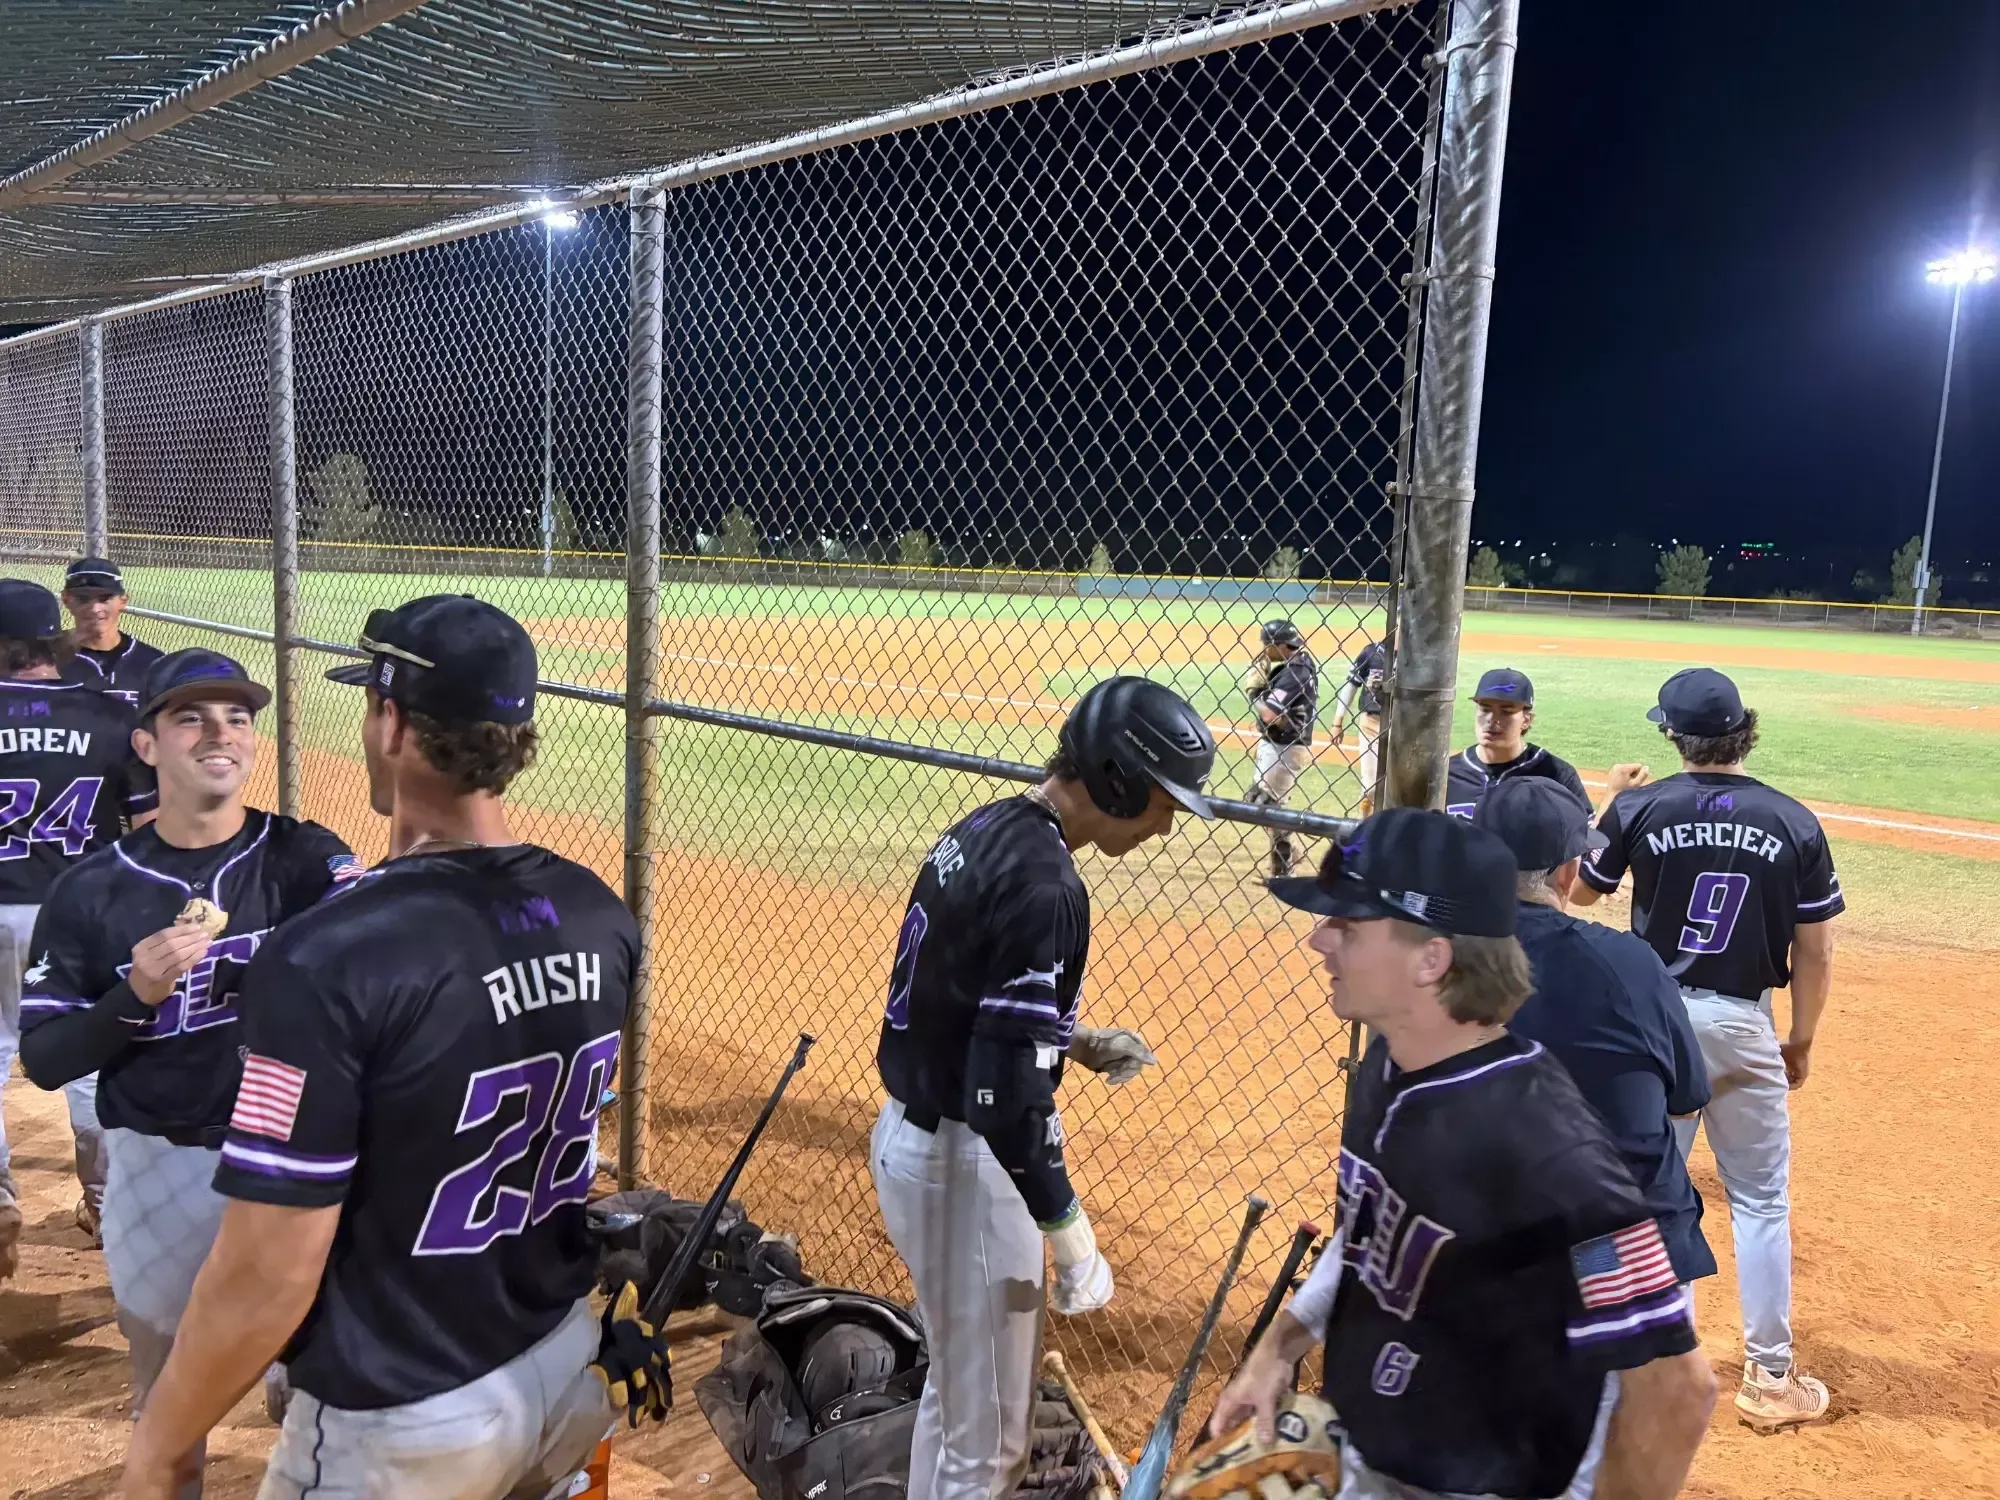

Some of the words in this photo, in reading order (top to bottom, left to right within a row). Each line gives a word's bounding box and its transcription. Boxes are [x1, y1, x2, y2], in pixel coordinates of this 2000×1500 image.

[0, 776, 104, 861] 24
[1646, 822, 1783, 863] MERCIER
[1677, 871, 1751, 954] 9
[482, 952, 601, 1025] RUSH
[411, 1030, 621, 1256] 28
[1371, 1341, 1421, 1396] 6
